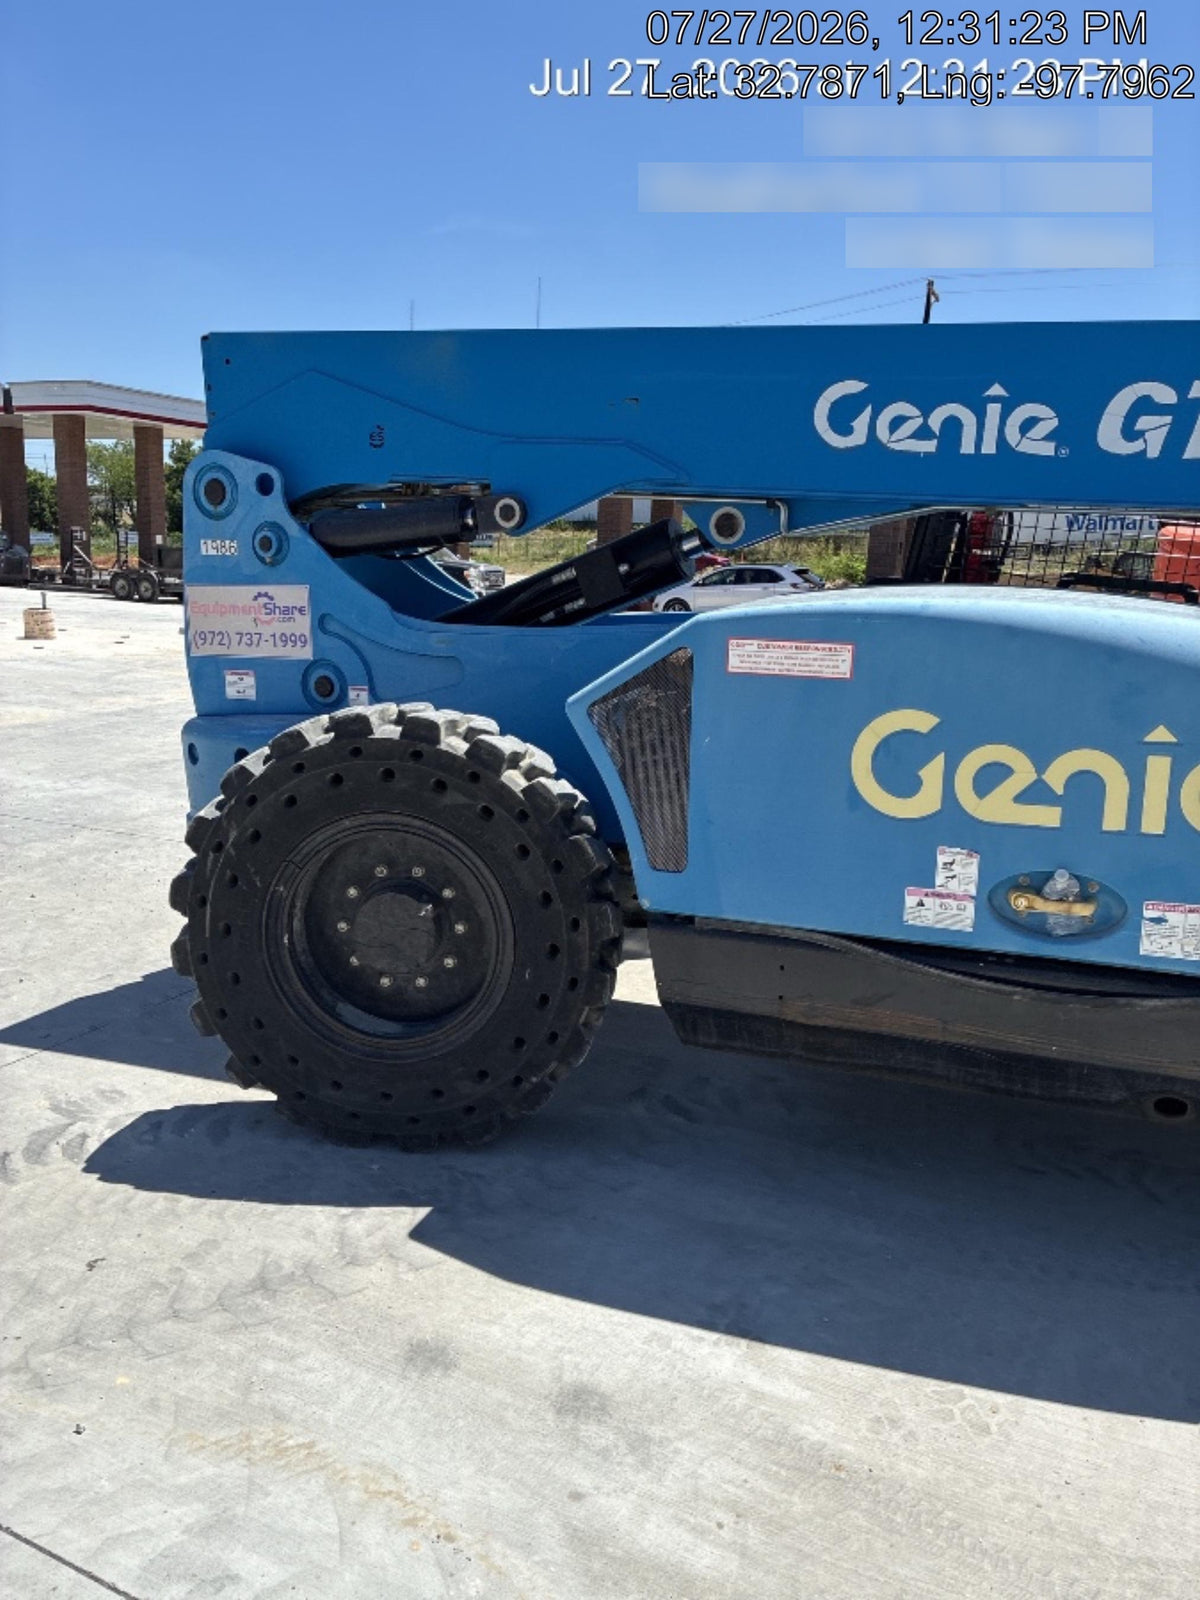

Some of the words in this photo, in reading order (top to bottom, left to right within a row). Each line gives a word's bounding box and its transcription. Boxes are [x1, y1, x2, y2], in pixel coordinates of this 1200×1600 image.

[813, 380, 1058, 456] Genie
[1065, 514, 1157, 533] Walmart
[203, 540, 238, 555] 1986
[193, 630, 232, 650] (972)
[235, 632, 308, 649] 737-1999
[851, 708, 1200, 835] Geni
